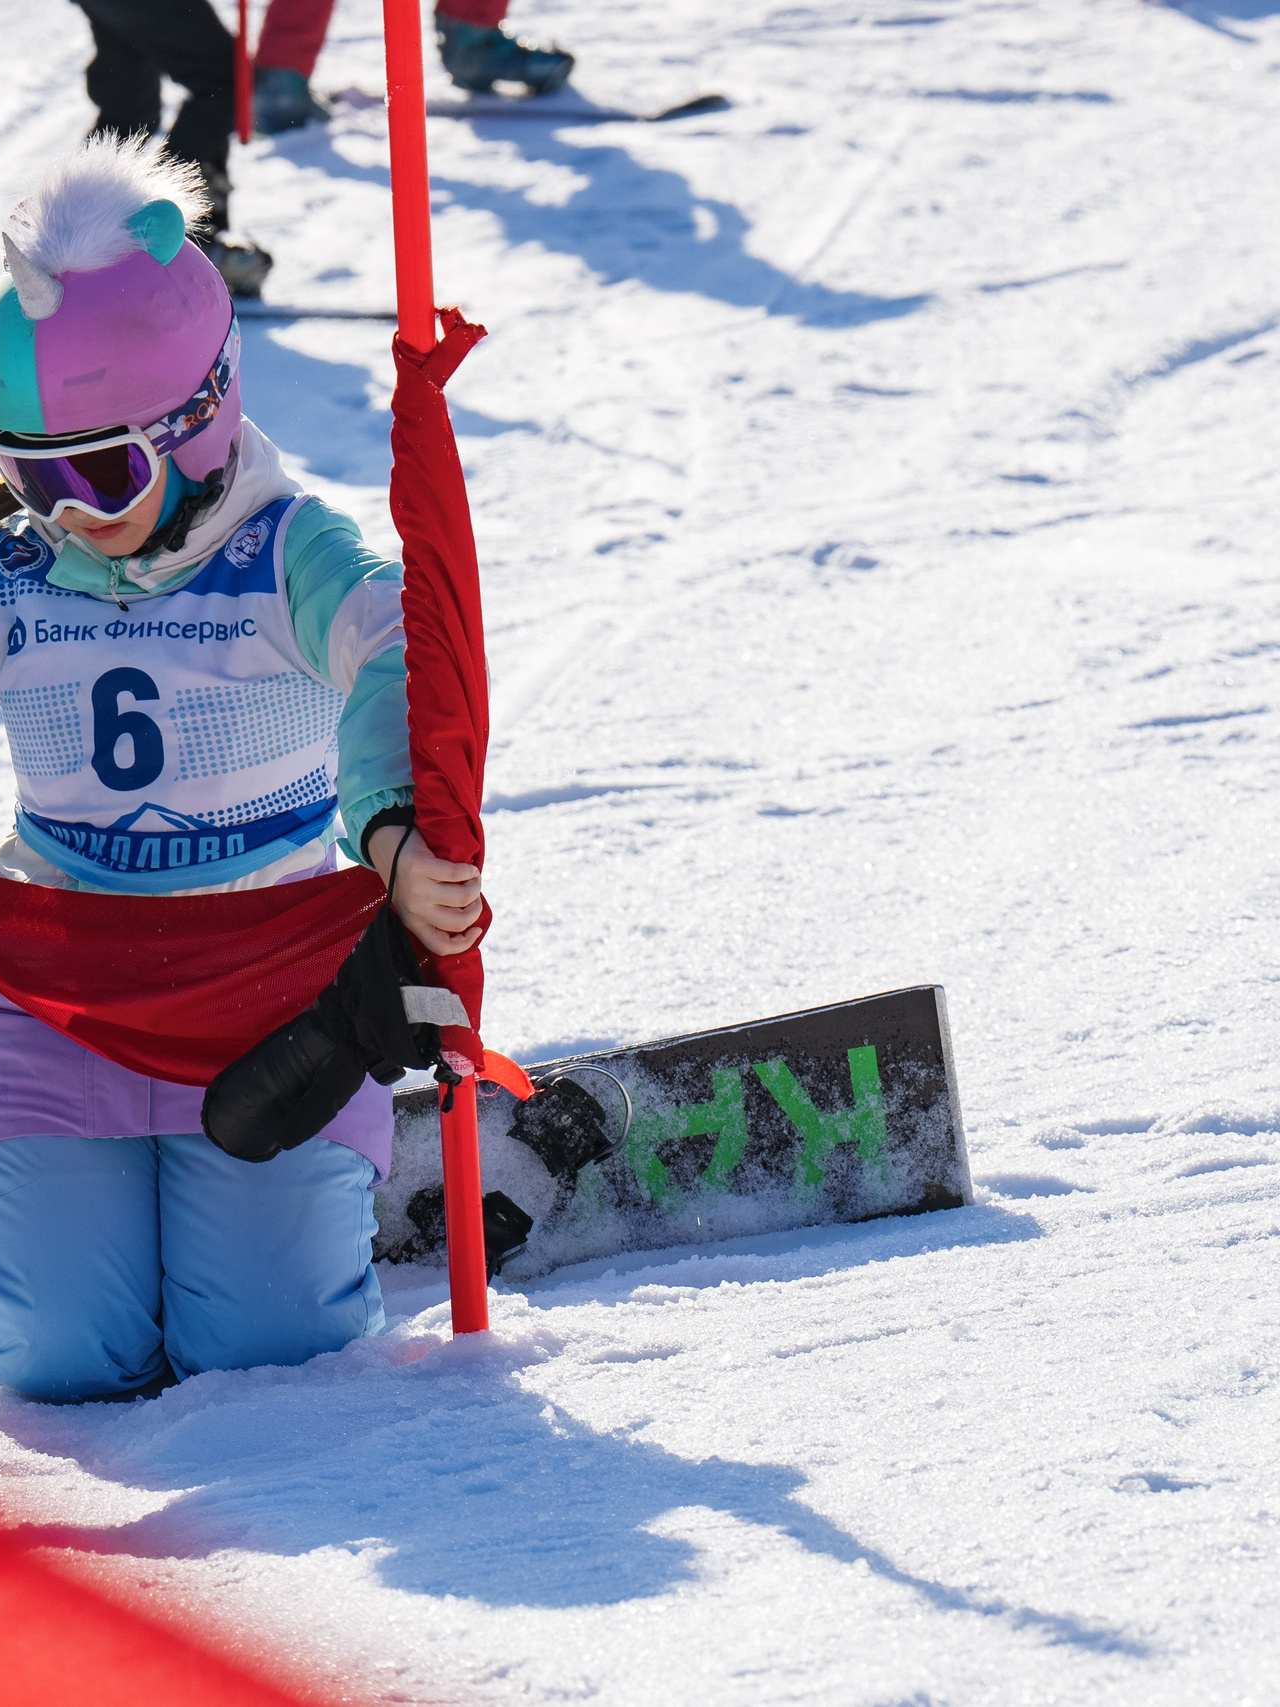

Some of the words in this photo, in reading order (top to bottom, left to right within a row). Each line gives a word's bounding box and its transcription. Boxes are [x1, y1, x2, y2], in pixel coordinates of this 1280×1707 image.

[34, 618, 98, 644] Банк
[104, 617, 258, 645] Финсервис
[91, 666, 165, 792] 6
